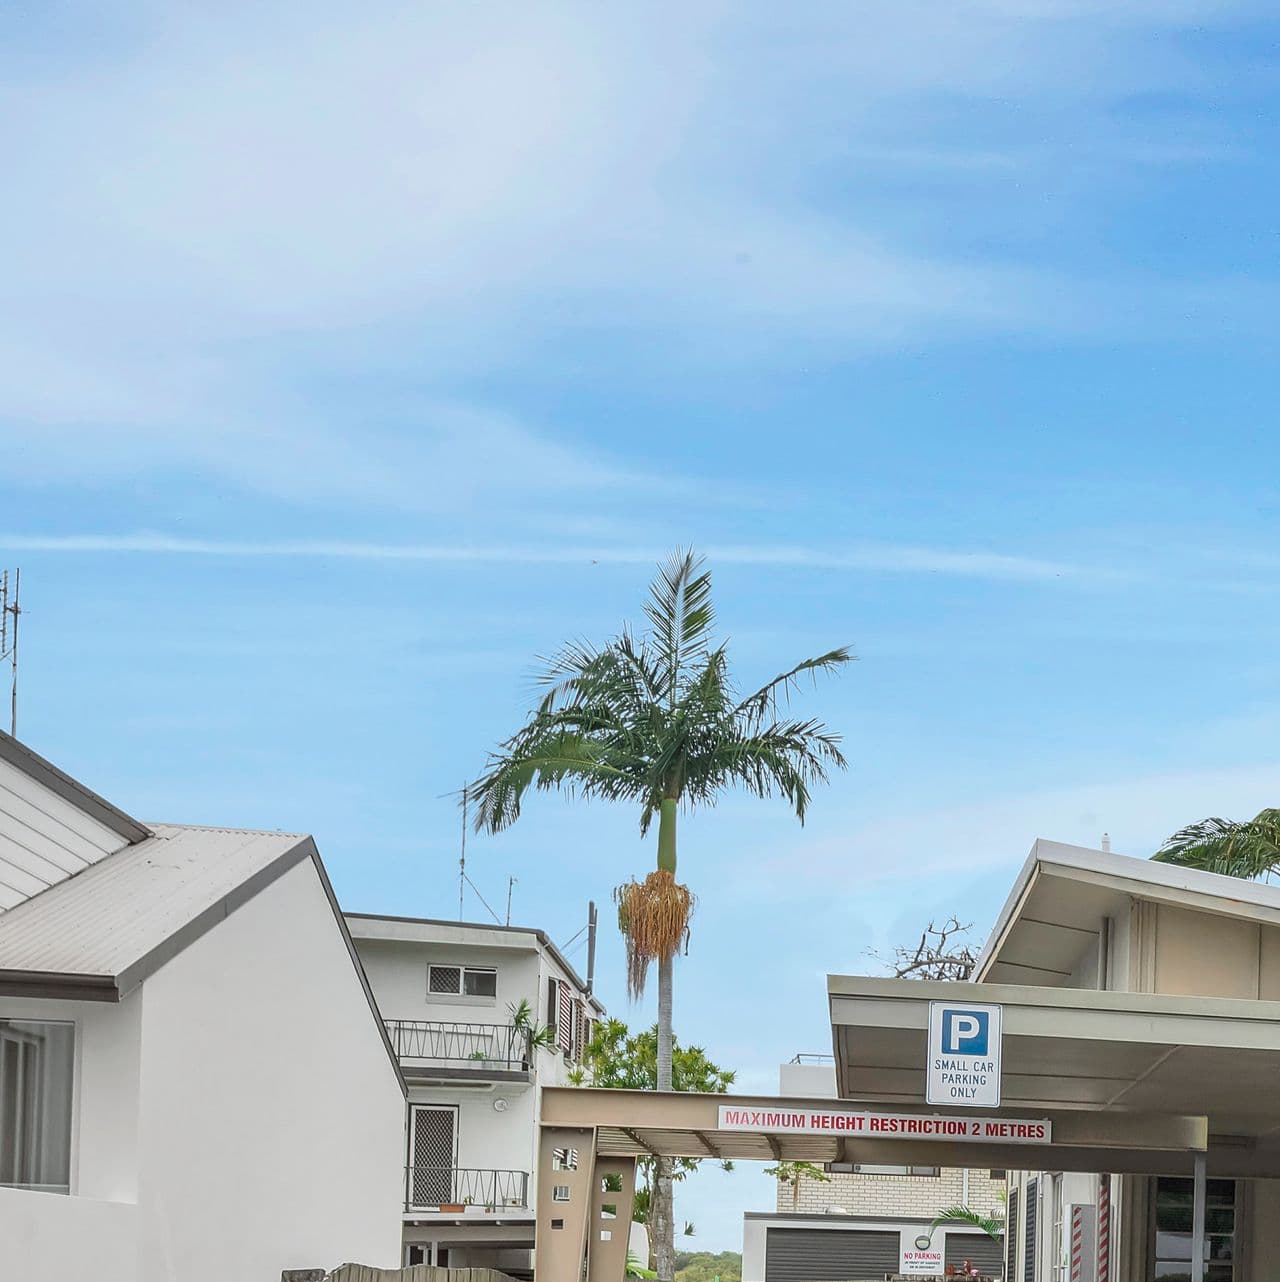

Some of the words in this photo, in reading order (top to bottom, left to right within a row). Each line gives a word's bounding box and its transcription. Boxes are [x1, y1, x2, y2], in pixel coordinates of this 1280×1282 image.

[950, 1014, 980, 1050] P
[934, 1060, 969, 1072] SMALL
[973, 1061, 994, 1073] CAR
[941, 1073, 987, 1086] PARKING
[950, 1087, 977, 1098] ONLY
[725, 1111, 806, 1128] MAXIMUM
[811, 1115, 865, 1131] HEIGHT
[870, 1118, 967, 1136] RESTRICTION
[972, 1122, 981, 1136] 2
[985, 1123, 1045, 1138] METRES
[904, 1252, 913, 1260] NO
[914, 1252, 941, 1260] PARKING
